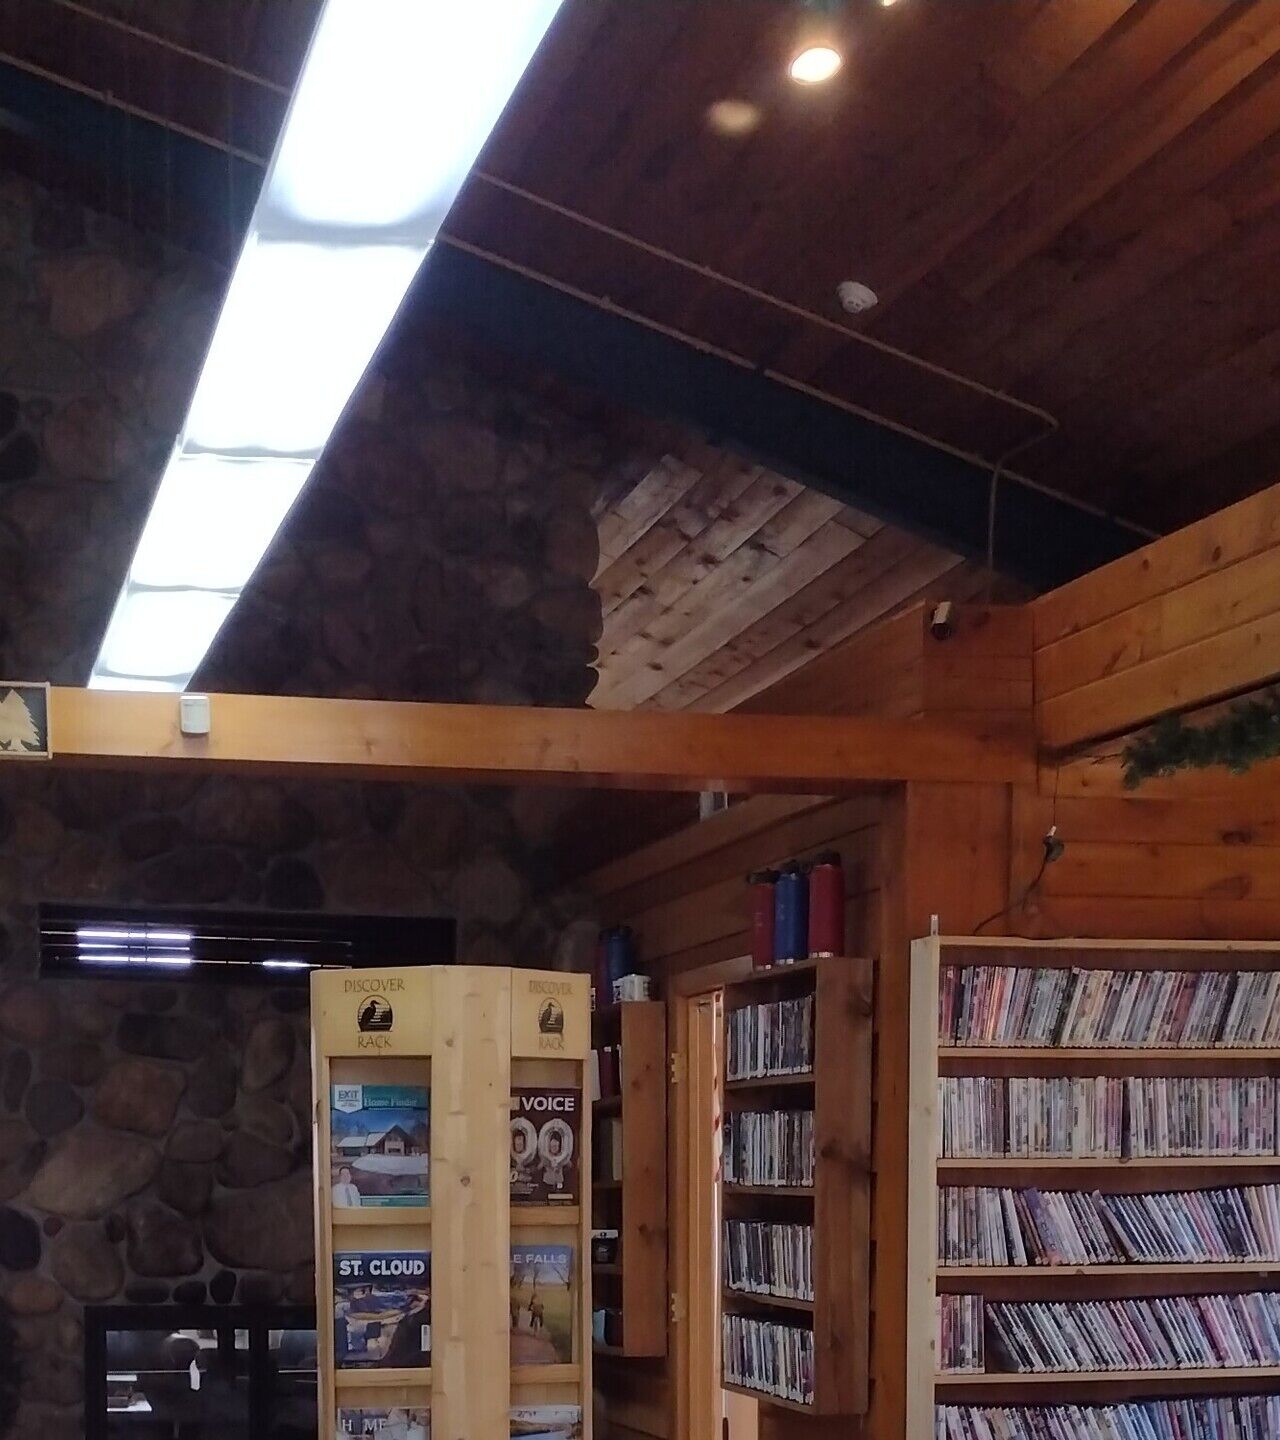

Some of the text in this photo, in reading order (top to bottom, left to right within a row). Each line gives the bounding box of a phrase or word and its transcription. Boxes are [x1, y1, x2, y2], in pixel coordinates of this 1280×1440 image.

[344, 978, 406, 994] DISCOVER
[528, 980, 573, 996] DISCOVER
[357, 1034, 392, 1050] RACK
[538, 1035, 564, 1051] RACK
[338, 1089, 359, 1099] EXIT
[522, 1096, 575, 1111] VOICE
[525, 1253, 567, 1265] FALLS
[339, 1259, 425, 1276] ST. CLOUD
